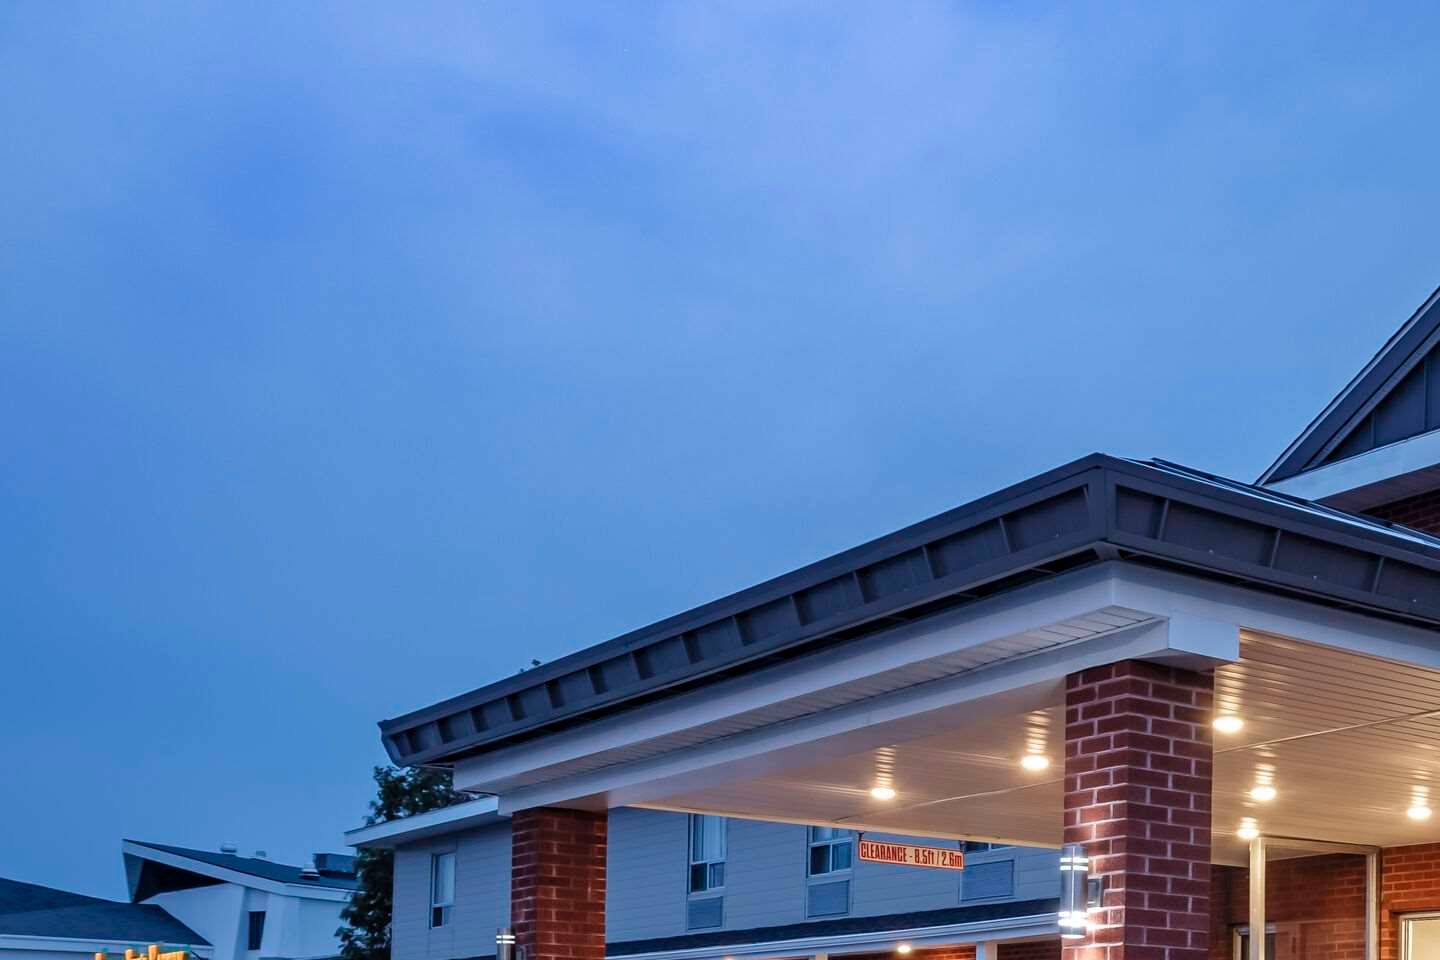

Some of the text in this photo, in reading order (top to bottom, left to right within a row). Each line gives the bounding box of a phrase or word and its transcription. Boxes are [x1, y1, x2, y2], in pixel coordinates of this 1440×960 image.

[861, 843, 907, 862] CLEARANCE
[914, 849, 935, 865] 8.5ft
[941, 852, 962, 867] 2.6m
